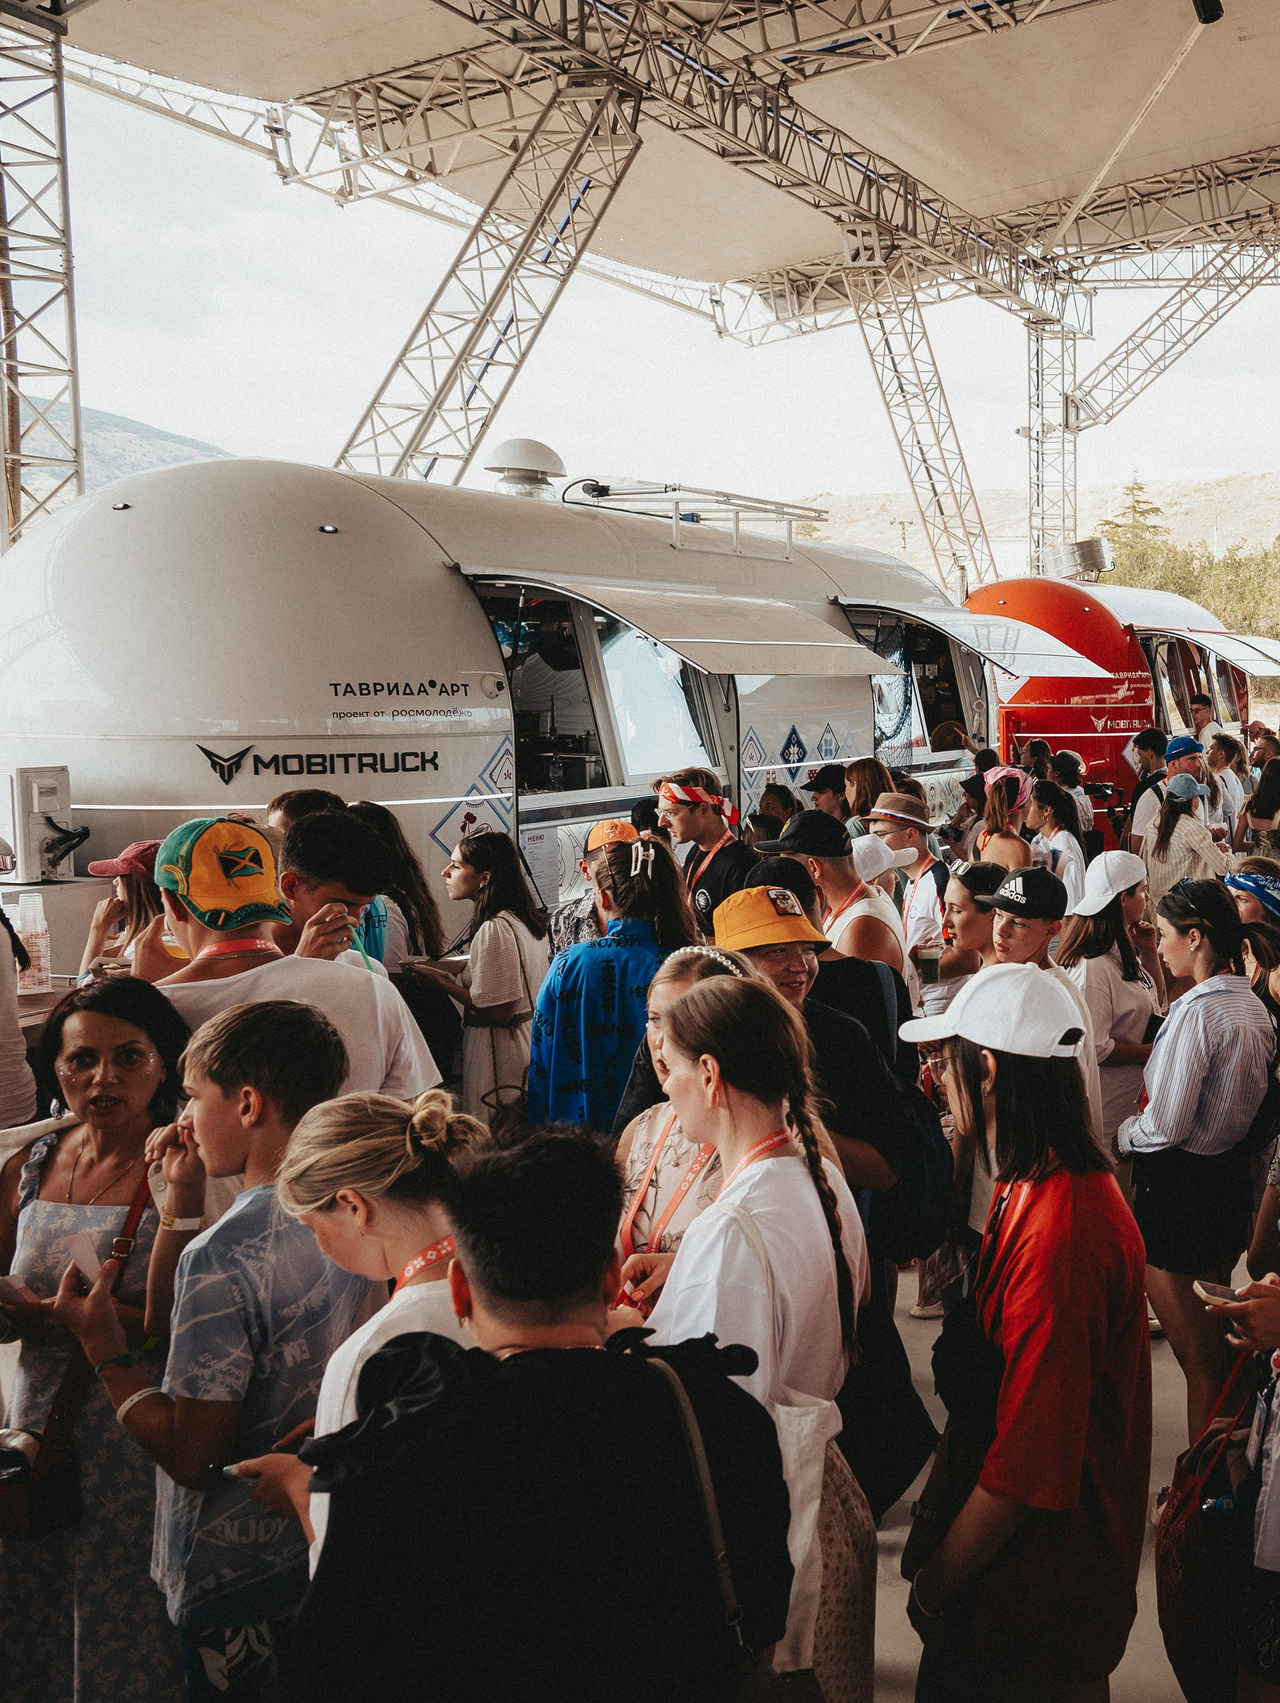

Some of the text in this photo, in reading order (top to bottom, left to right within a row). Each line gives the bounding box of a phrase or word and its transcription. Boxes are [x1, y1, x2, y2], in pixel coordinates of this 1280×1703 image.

[332, 707, 473, 721] проект от росмолодёжь
[253, 750, 439, 776] MOBITRUCK
[527, 834, 545, 843] МЕНЮ
[999, 887, 1027, 904] adidas
[215, 1518, 289, 1544] ENJOY
